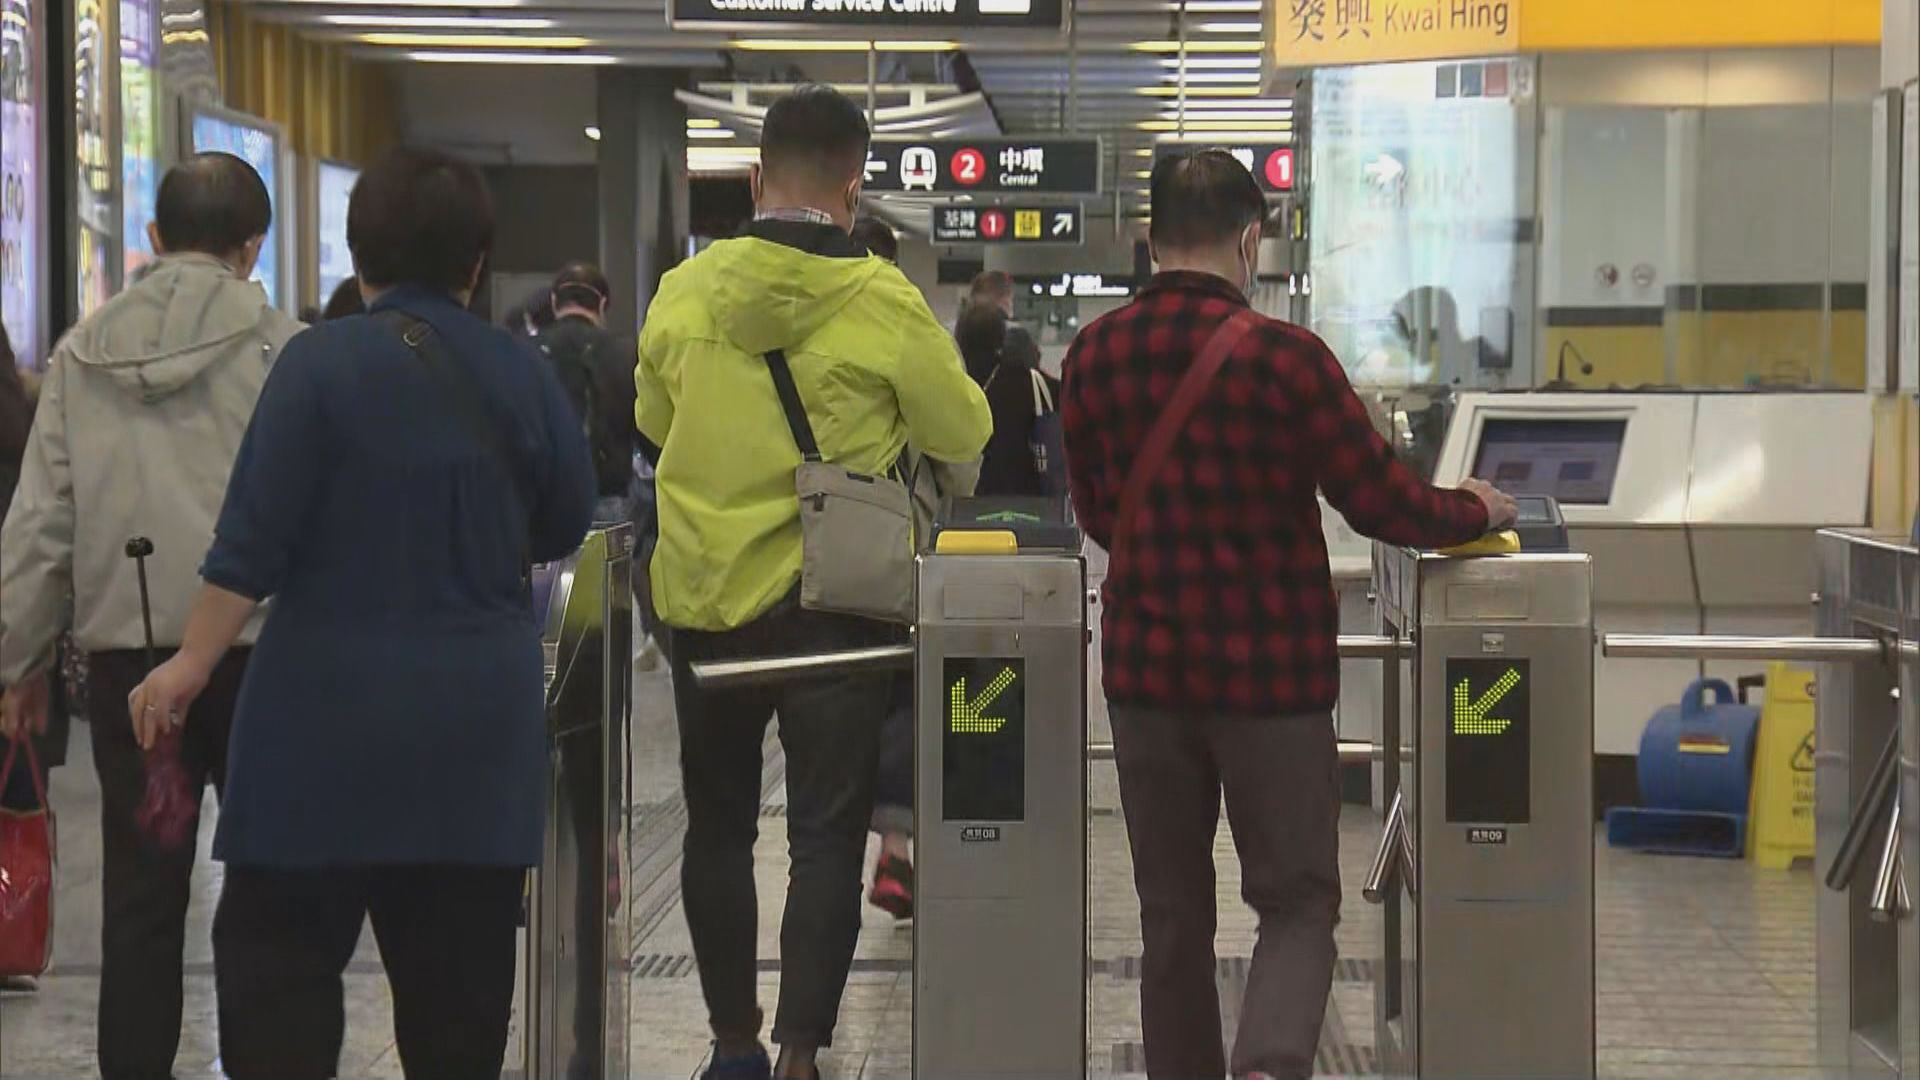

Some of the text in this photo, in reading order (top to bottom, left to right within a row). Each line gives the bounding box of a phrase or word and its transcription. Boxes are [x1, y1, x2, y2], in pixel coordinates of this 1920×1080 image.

[711, 0, 955, 13] Customer Service Centre
[1385, 0, 1509, 36] Kwai Hing
[959, 154, 977, 179] 2
[1277, 155, 1291, 182] 1
[999, 173, 1038, 186] Central
[988, 214, 997, 233] 1
